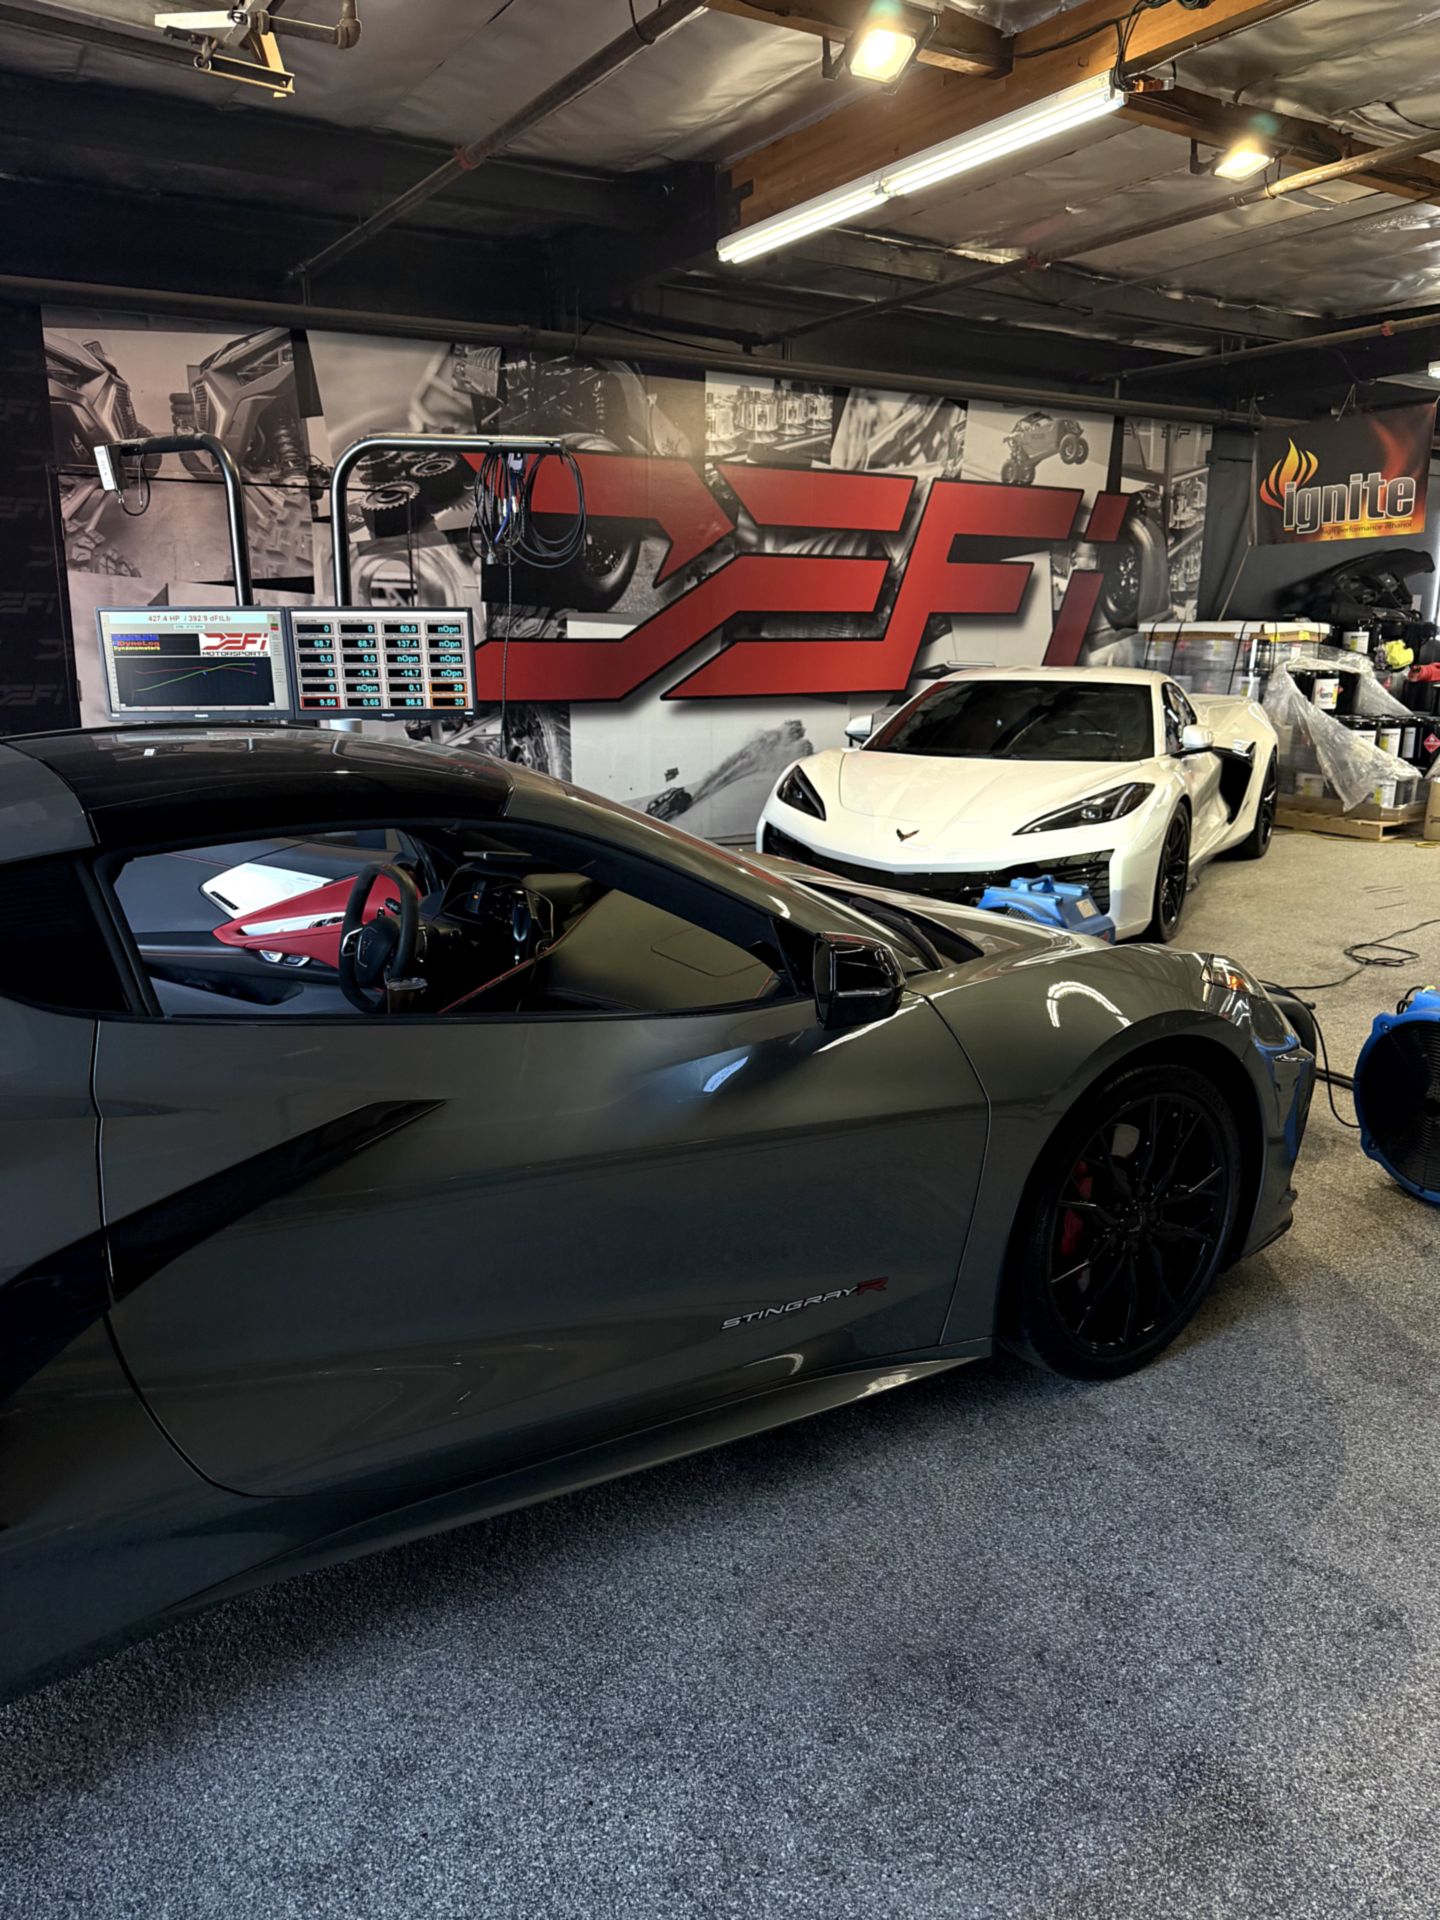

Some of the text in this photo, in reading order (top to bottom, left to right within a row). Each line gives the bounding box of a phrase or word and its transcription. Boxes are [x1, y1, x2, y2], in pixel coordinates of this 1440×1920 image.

[1283, 471, 1416, 534] ignite
[1337, 523, 1383, 534] performance
[1384, 521, 1412, 530] ethanol
[460, 450, 1133, 702] DEFi
[437, 626, 459, 634] nOpn
[202, 633, 269, 650] DEFi
[313, 640, 330, 648] 68.7
[438, 640, 460, 648] nOpn
[396, 655, 418, 663] nOpn
[439, 655, 461, 663] nOpn
[440, 670, 462, 678] nOpn
[720, 1276, 889, 1330] STINGRAY R
